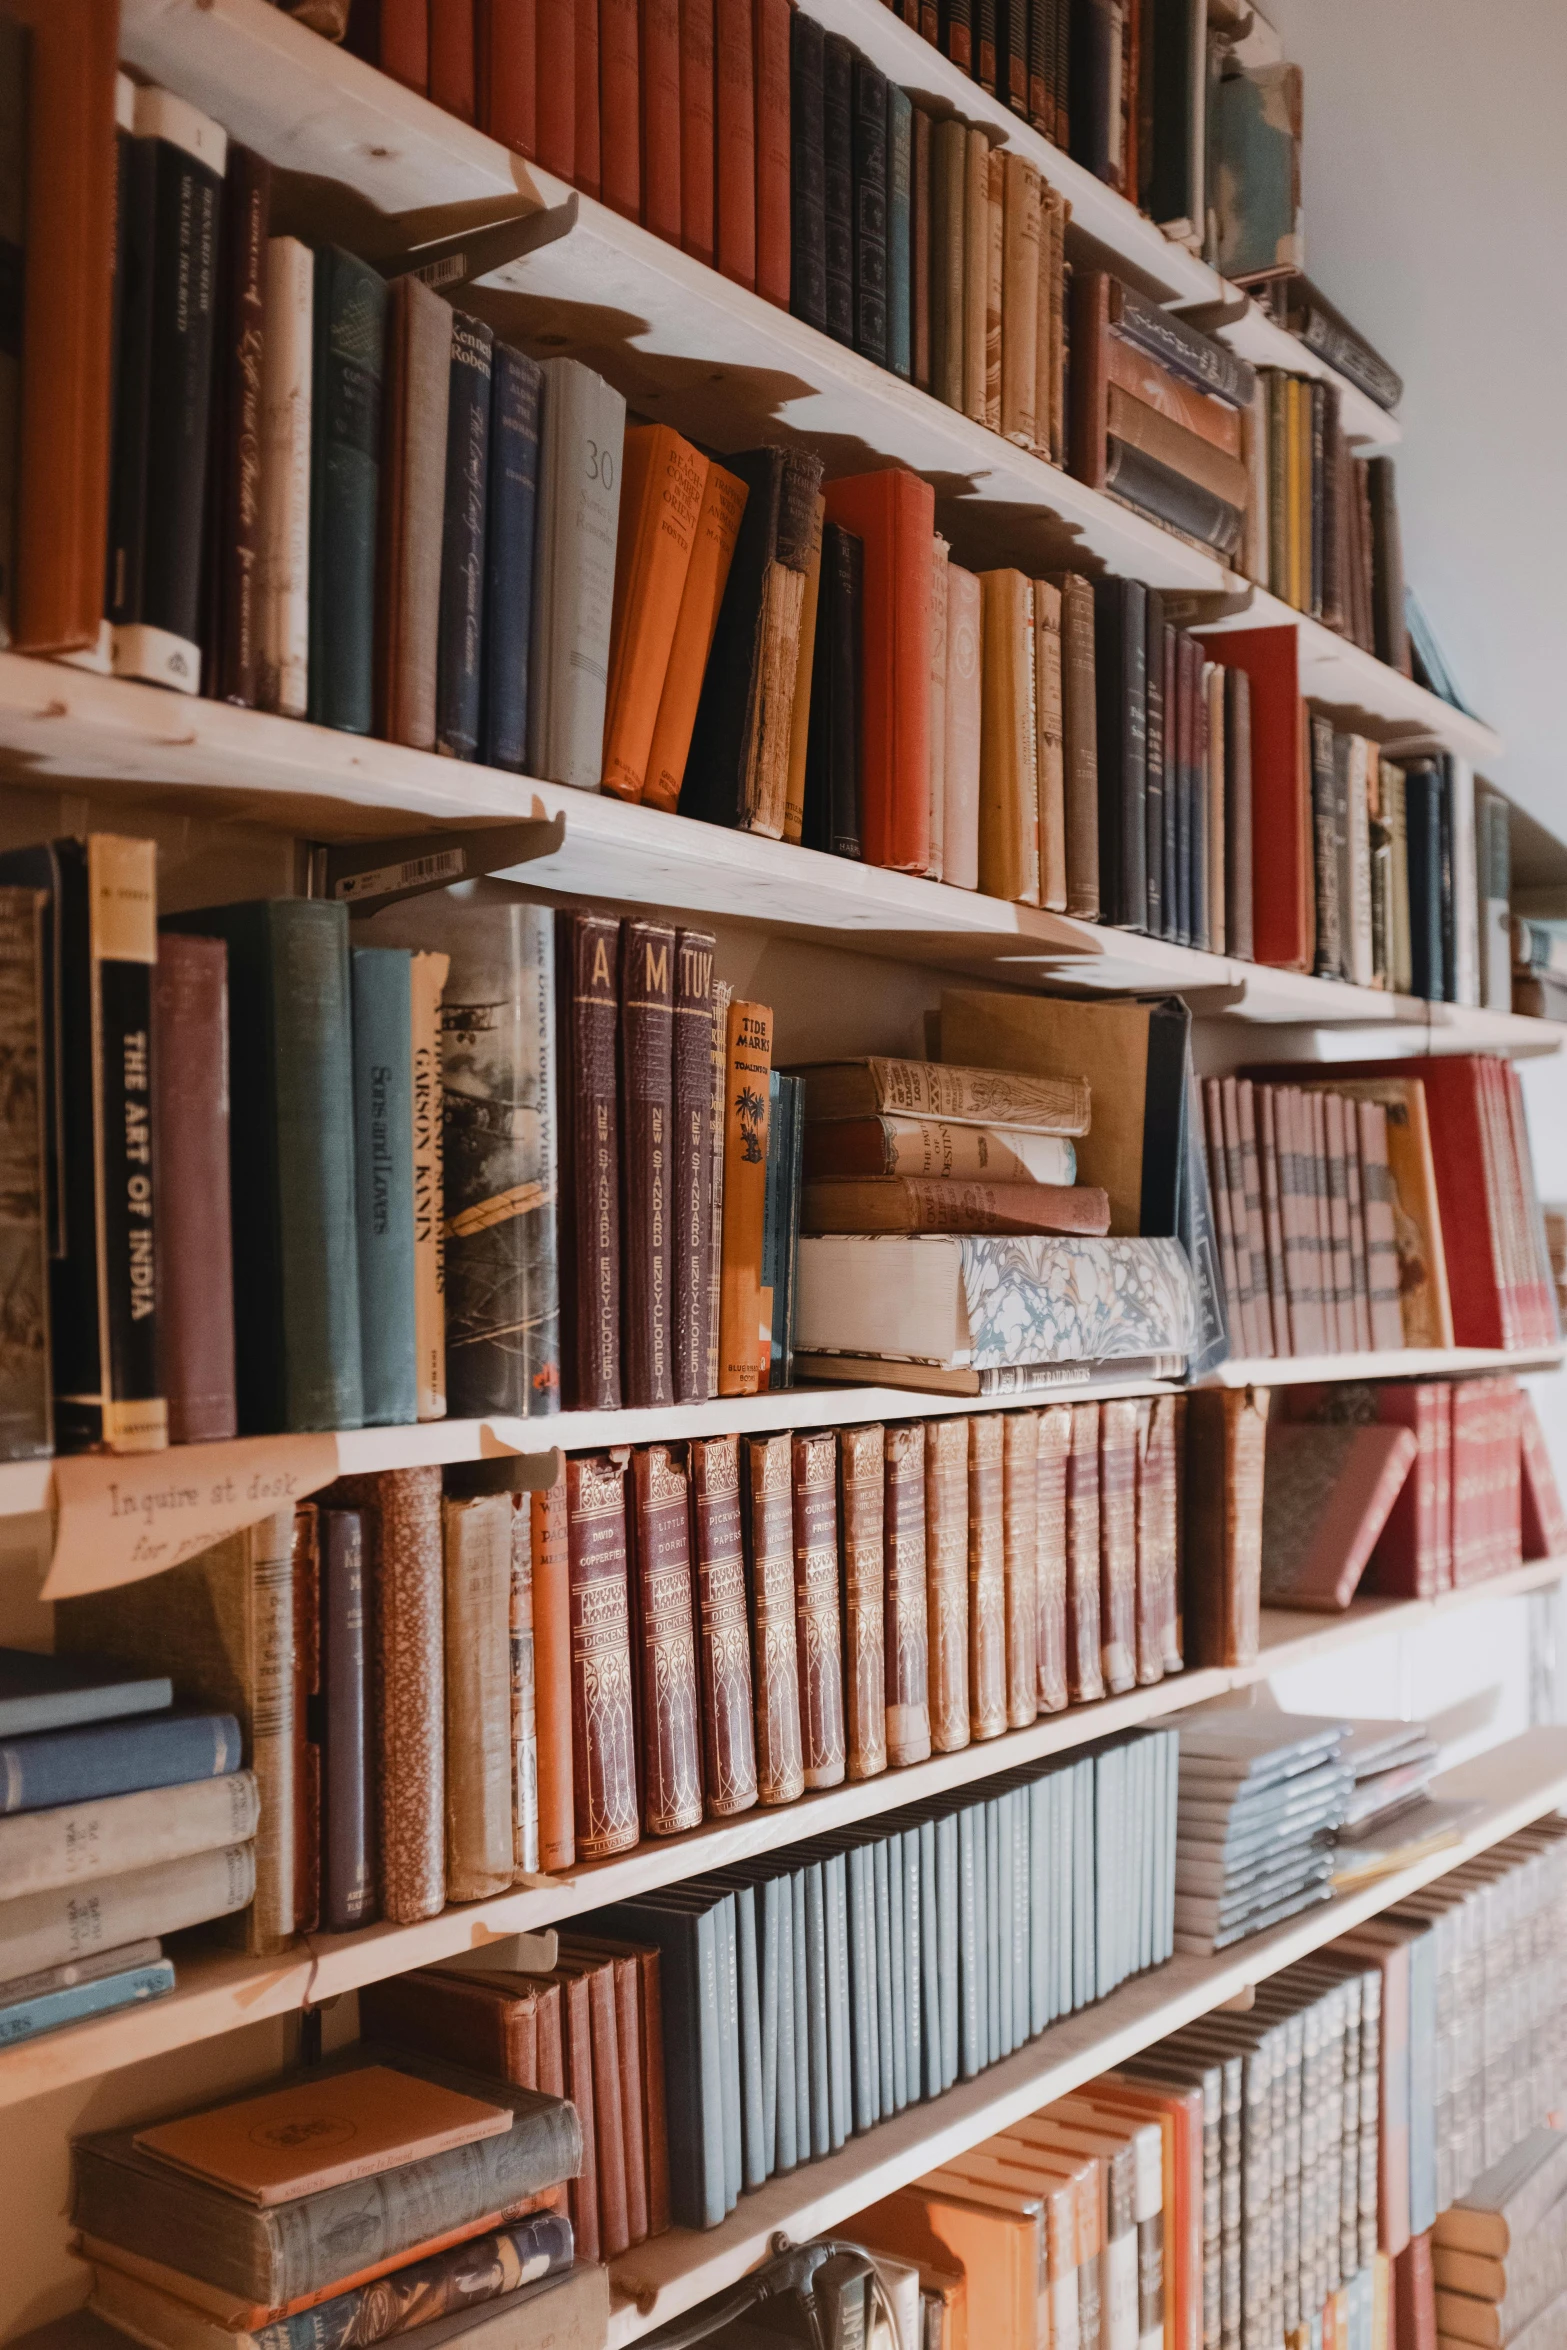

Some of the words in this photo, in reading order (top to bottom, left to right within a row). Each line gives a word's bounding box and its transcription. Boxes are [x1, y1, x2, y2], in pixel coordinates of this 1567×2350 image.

[585, 439, 613, 490] 30
[591, 937, 611, 988] A
[645, 942, 667, 994] M
[682, 948, 713, 999] TUV
[735, 1034, 770, 1053] MARKS
[742, 1017, 766, 1036] TIDE
[123, 1030, 148, 1092] THE
[734, 1061, 769, 1076] TOMLINSON
[371, 1065, 392, 1119] Sons
[415, 1047, 431, 1151] GARSON
[909, 1069, 921, 1102] LOST
[124, 1100, 150, 1165] ART
[371, 1121, 392, 1161] and
[597, 1105, 608, 1142] NEW
[652, 1107, 663, 1144] NEW
[691, 1111, 701, 1145] NEW
[922, 1150, 931, 1172] THE
[933, 1138, 940, 1154] OF
[127, 1174, 151, 1219] OF
[372, 1165, 392, 1235] Lovers
[415, 1165, 431, 1244] KANIN
[598, 1148, 610, 1248] STANDARD
[652, 1150, 663, 1247] STANDARD
[691, 1152, 701, 1247] STANDARD
[923, 1185, 936, 1224] OVER
[128, 1229, 155, 1321] INDIA
[600, 1257, 614, 1404] ENCYCLOPEDIA
[653, 1256, 665, 1400] ENCYCLOPEDIA
[690, 1256, 700, 1396] ENCYCLOPEDIA
[728, 1364, 746, 1372] BLUE
[107, 1483, 199, 1525] Inquire
[247, 1472, 298, 1500] desk
[546, 1484, 567, 1501] BOY
[805, 1504, 821, 1516] OUR
[553, 1514, 562, 1526] A
[592, 1528, 614, 1542] DAVID
[658, 1516, 685, 1532] LITTLE
[713, 1530, 742, 1546] PAPERS
[584, 1625, 629, 1648] DICKENS
[346, 2168, 354, 2180] A
[356, 2163, 374, 2177] Year
[386, 2151, 413, 2168] Round
